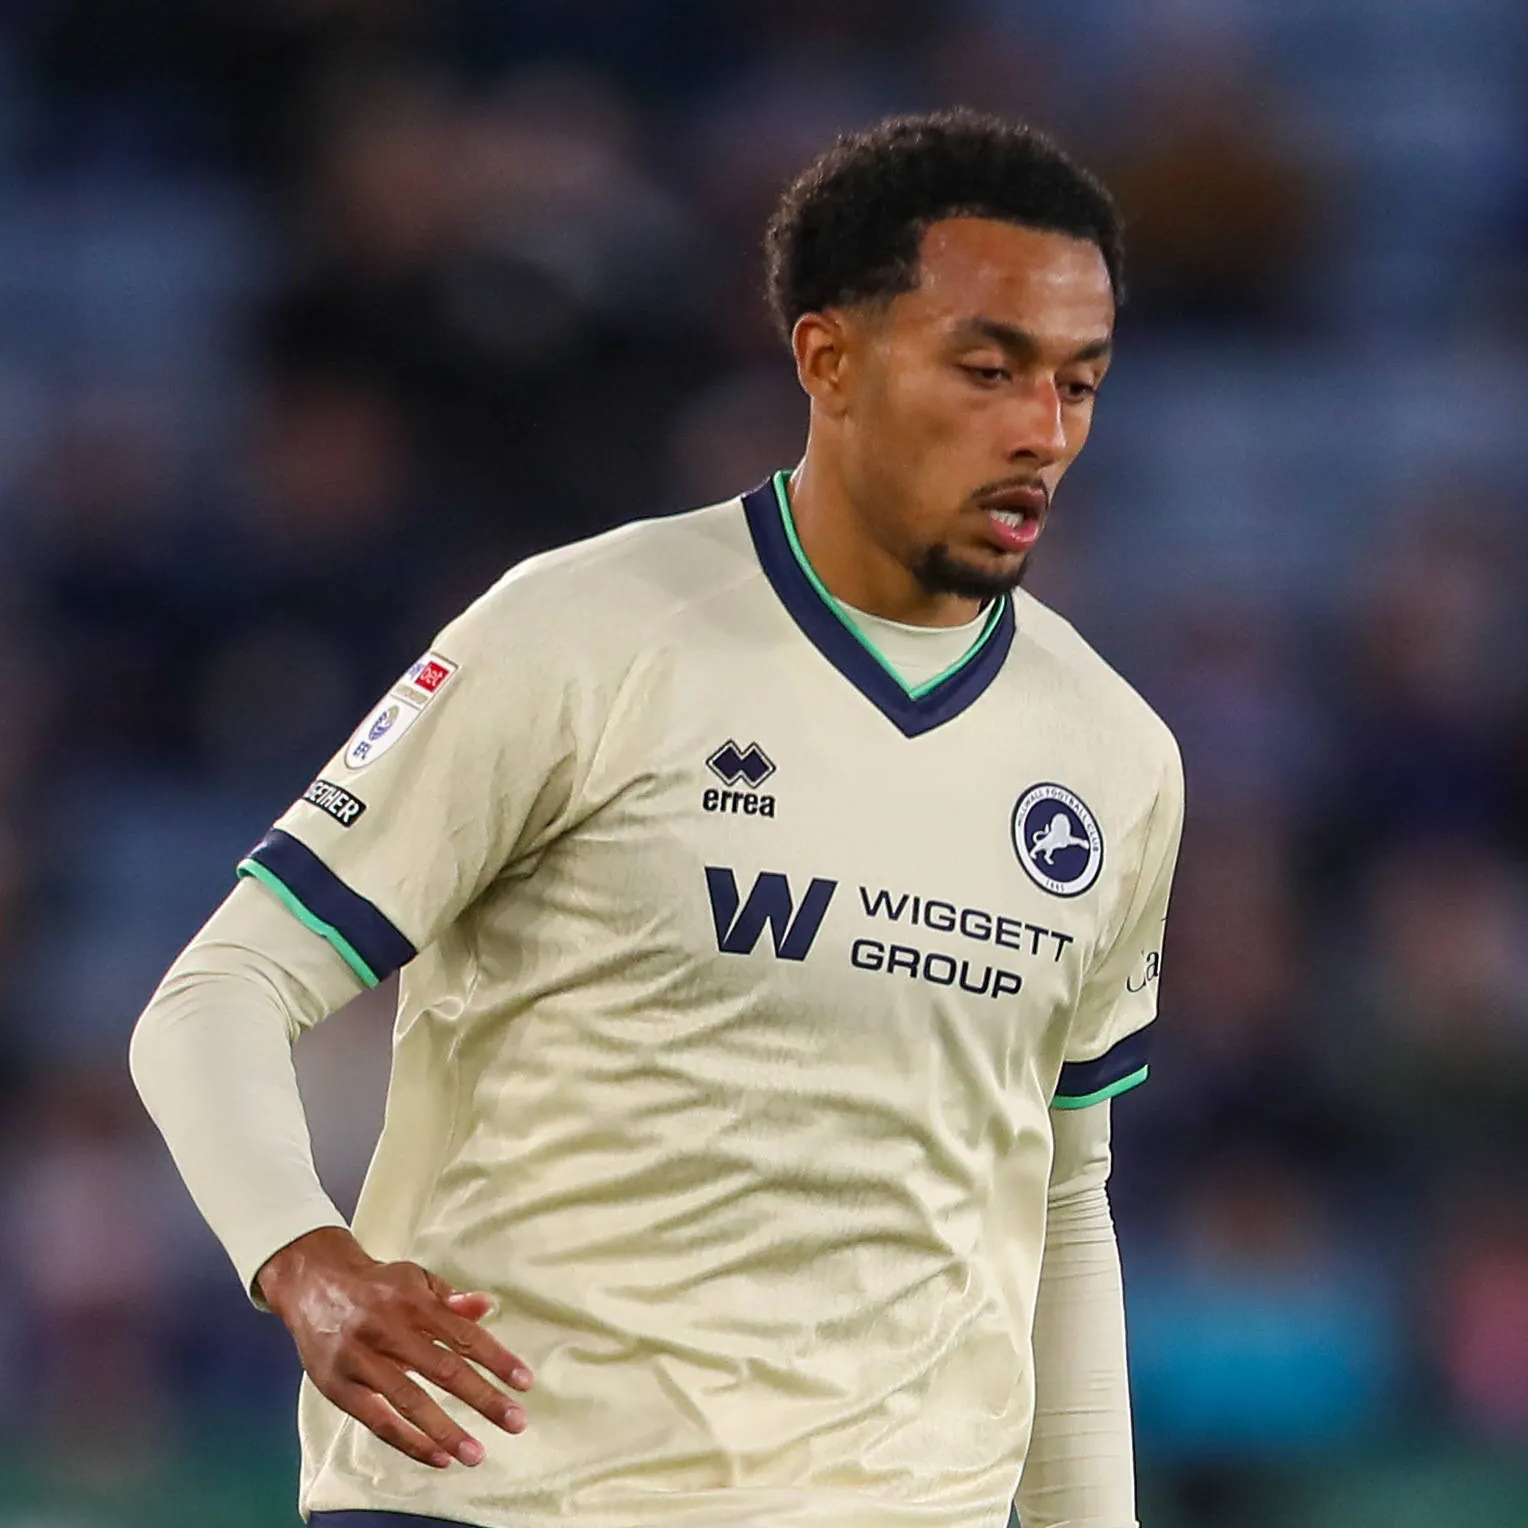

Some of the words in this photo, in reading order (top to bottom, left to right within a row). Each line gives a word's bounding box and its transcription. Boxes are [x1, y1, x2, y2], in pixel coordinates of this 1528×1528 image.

[702, 786, 776, 818] errea
[858, 885, 1075, 963] WIGGETT
[851, 938, 1023, 999] GROUP
